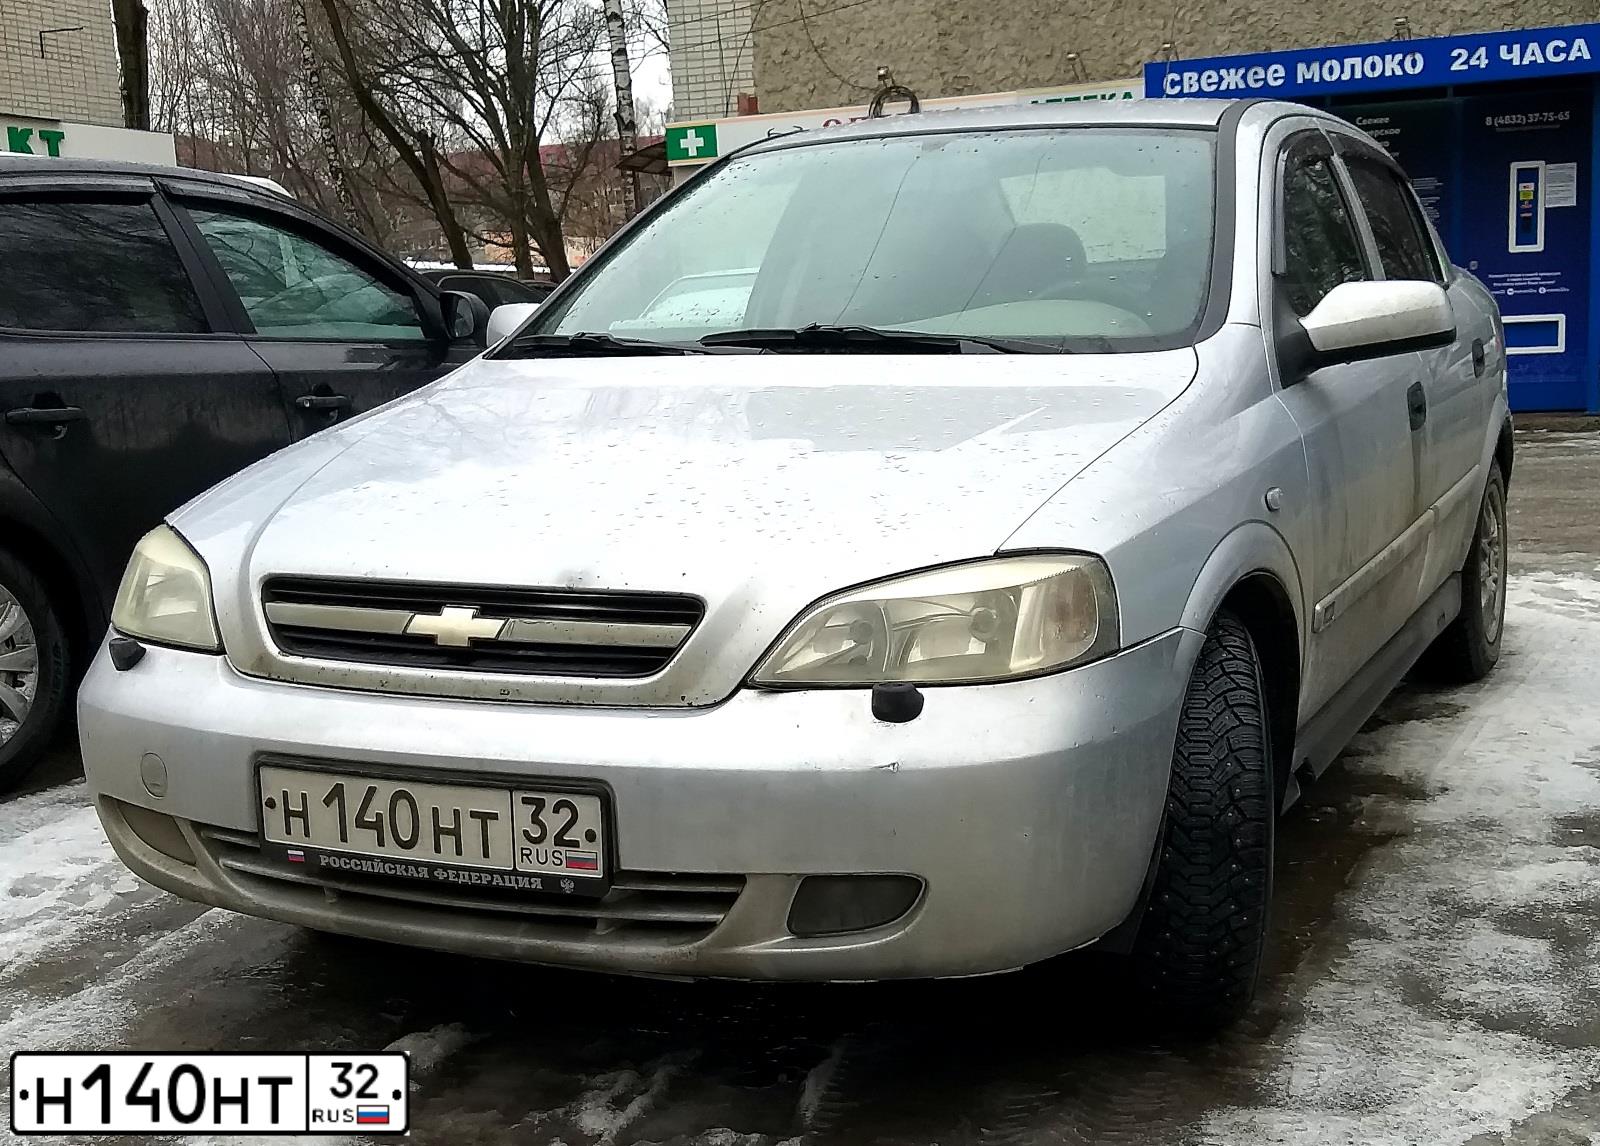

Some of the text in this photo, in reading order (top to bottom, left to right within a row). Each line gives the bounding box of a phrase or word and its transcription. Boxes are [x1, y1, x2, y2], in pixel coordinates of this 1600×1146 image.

[1450, 47, 1489, 71] 24
[1500, 38, 1591, 66] ЧАСА
[520, 796, 581, 849] 32
[319, 854, 543, 890] РОССИЙСКАЯ ФЕДЕРАЦИЯ
[520, 847, 564, 867] RUS
